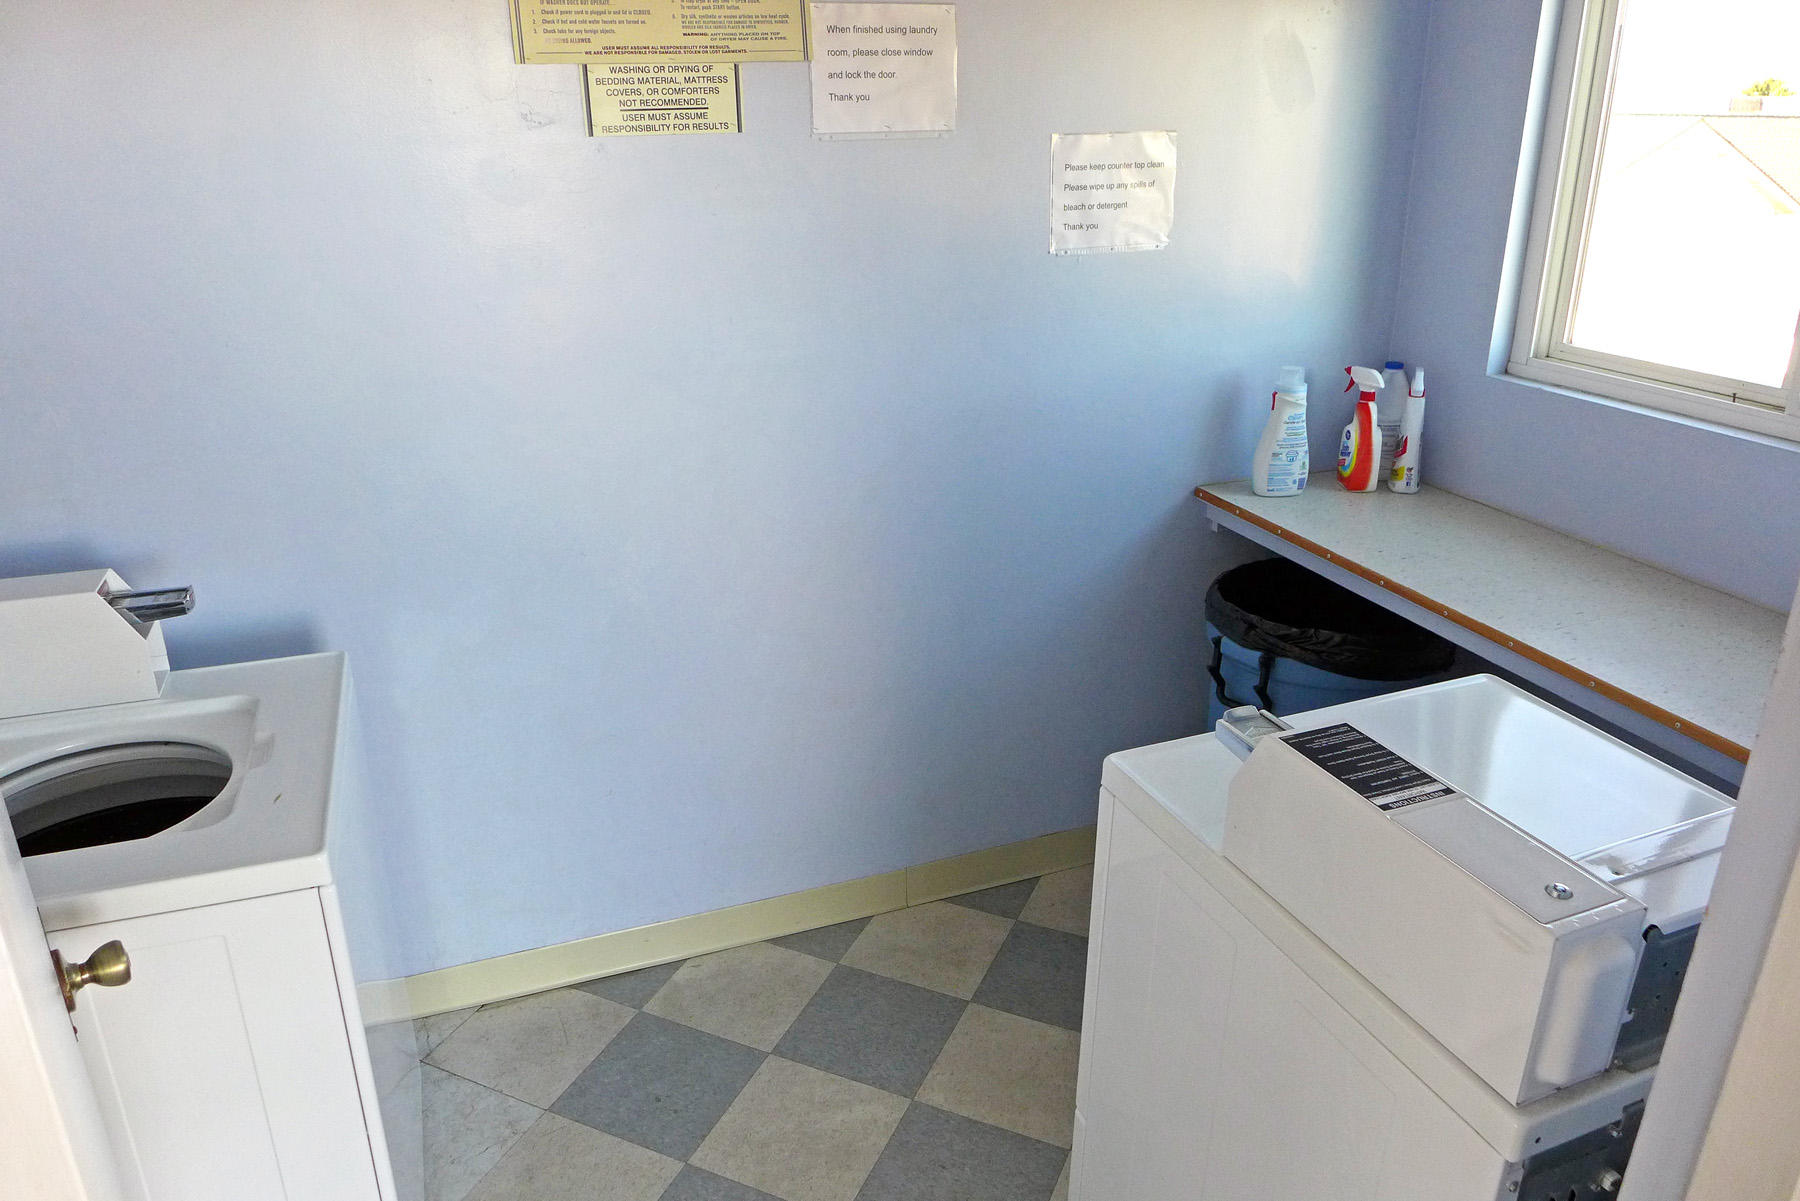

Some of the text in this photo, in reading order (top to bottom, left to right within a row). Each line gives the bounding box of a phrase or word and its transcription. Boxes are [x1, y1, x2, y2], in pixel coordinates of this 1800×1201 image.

[827, 25, 938, 36] When finished using laundry
[827, 48, 933, 58] room, please close window
[609, 65, 714, 74] WASHING OR DRYING OF
[828, 71, 843, 79] and
[845, 71, 861, 79] lock
[864, 71, 876, 79] the
[595, 76, 728, 86] BEDDING MATERIAL, MATTRESS
[606, 88, 644, 97] COVERS,
[661, 87, 720, 95] COMFORTERS
[619, 98, 709, 107] NOT RECOMMENDED.
[829, 93, 870, 102] Thank you
[622, 112, 708, 122] USER MUST ASSUME
[602, 122, 729, 133] RESPONSIBILITY FOR RESULTS
[1064, 163, 1087, 172] Please
[1089, 163, 1106, 171] keep
[1107, 162, 1133, 170] counter
[1063, 184, 1087, 192] Please
[1089, 183, 1104, 191] wipe
[1130, 180, 1147, 189] spills
[1063, 203, 1086, 211] bleach
[1096, 201, 1128, 210] detergent
[1064, 223, 1099, 231] Thank you
[1388, 790, 1446, 808] INSTRUCTIONS
